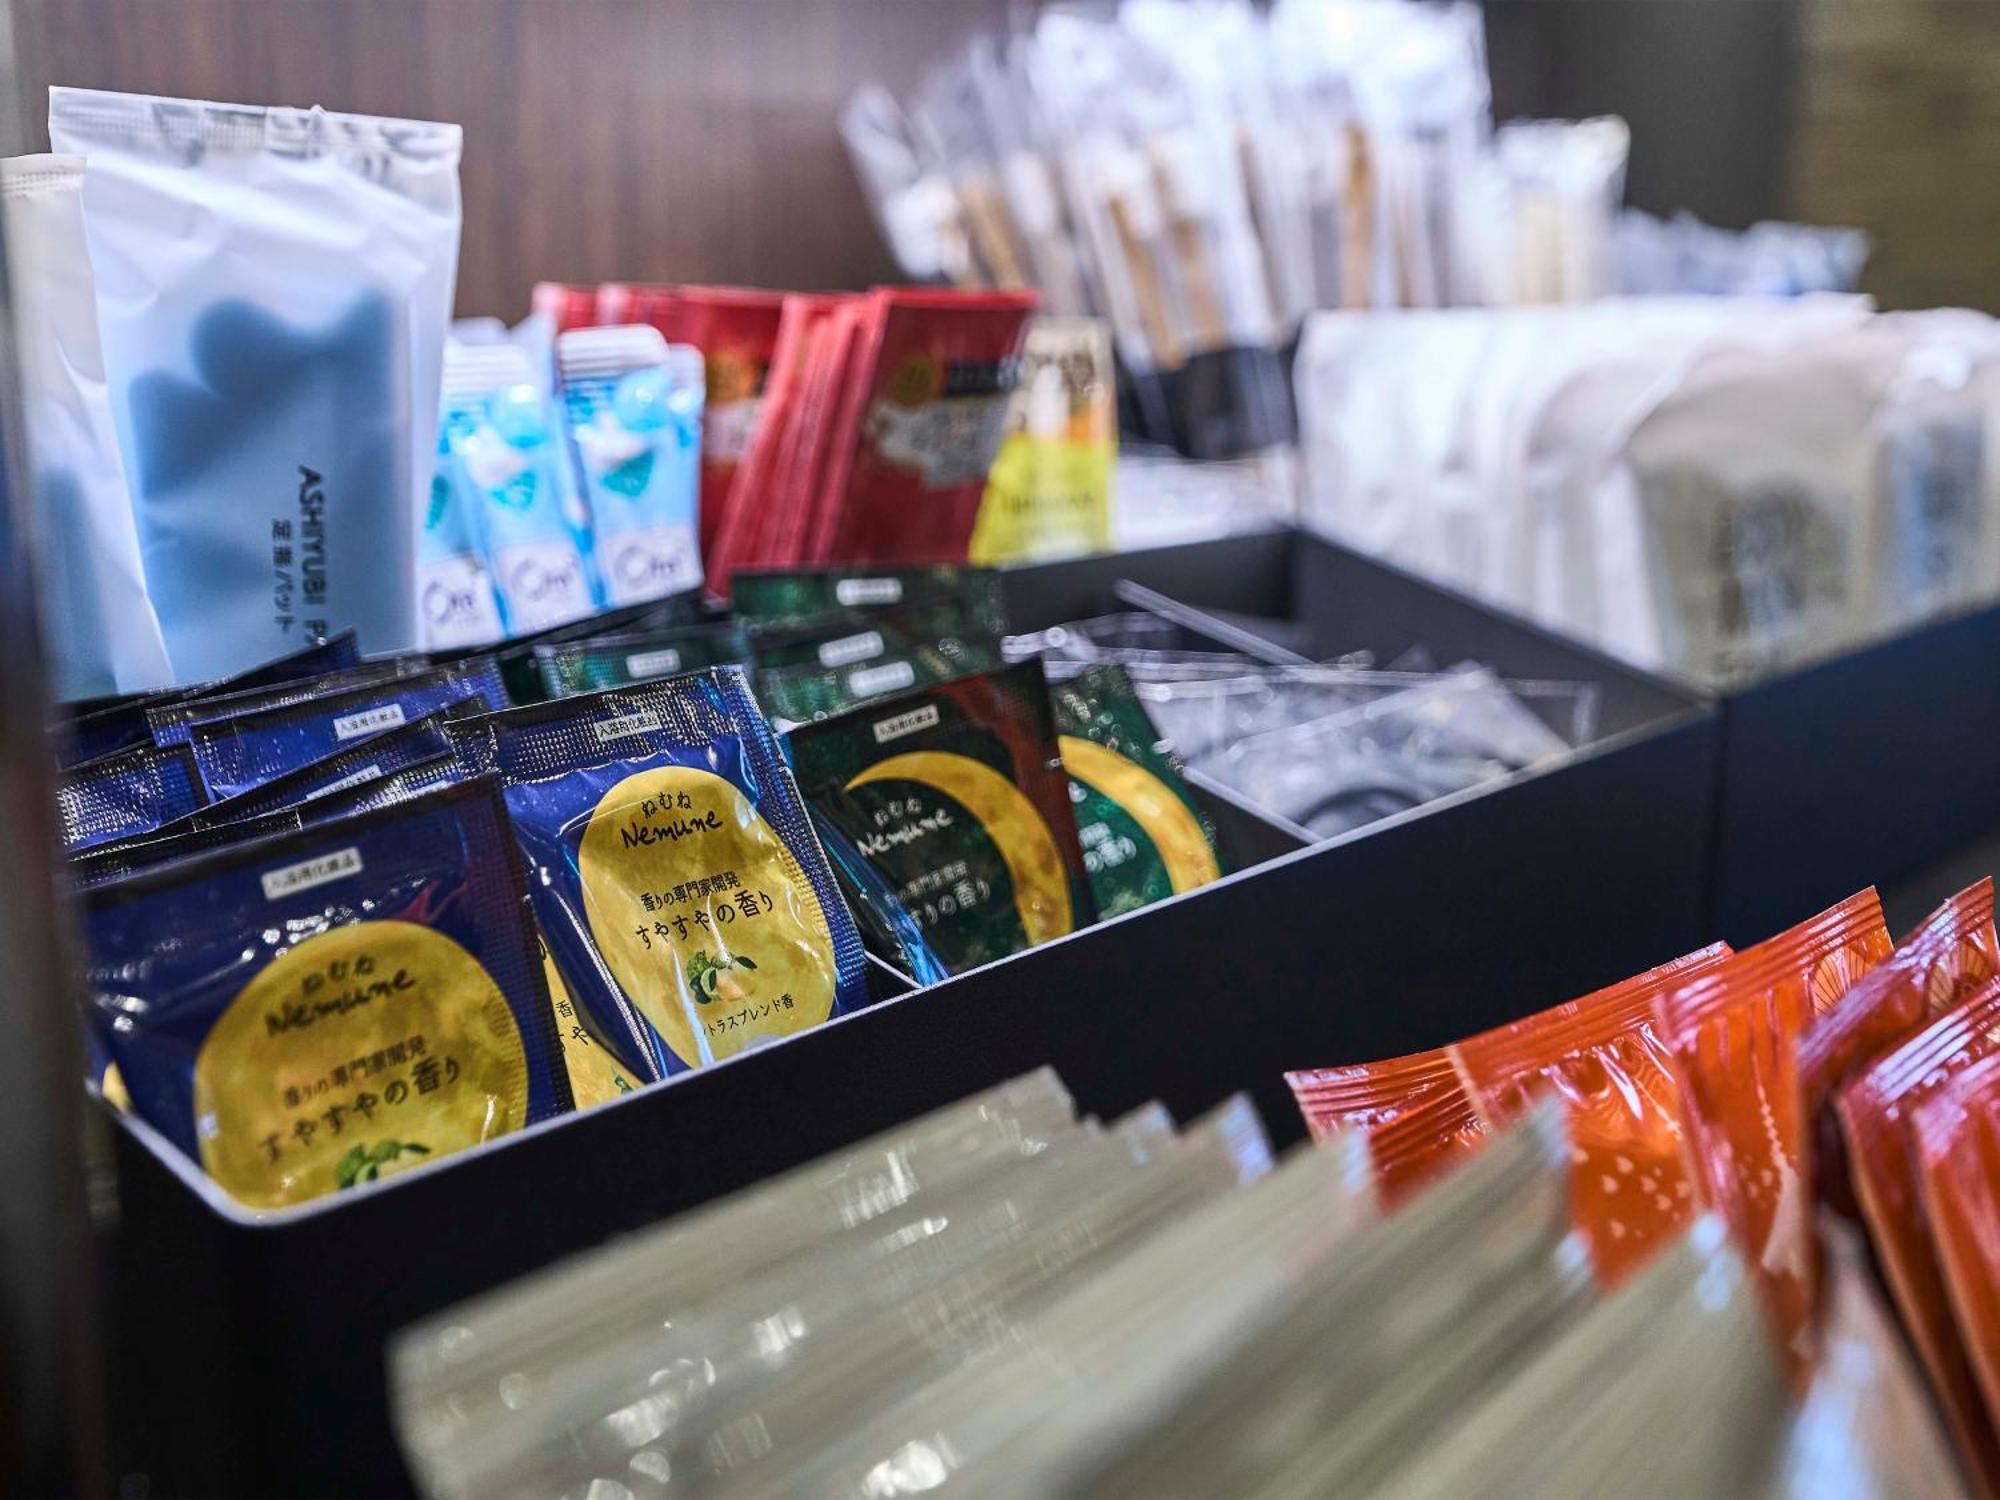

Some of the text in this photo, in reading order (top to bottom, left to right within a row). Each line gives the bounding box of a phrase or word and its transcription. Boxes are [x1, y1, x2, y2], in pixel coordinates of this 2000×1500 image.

[298, 465, 326, 605] ASHIYUBI
[620, 810, 723, 849] Nemune
[642, 791, 692, 819] ねむね
[856, 808, 953, 857] Nemune
[641, 871, 741, 912] 香りの専門家開発
[636, 889, 774, 950] すやすやの香り
[265, 969, 416, 1037] Nemune
[702, 992, 795, 1038] トラスブレンド香
[260, 1056, 460, 1165] すやすやの香り
